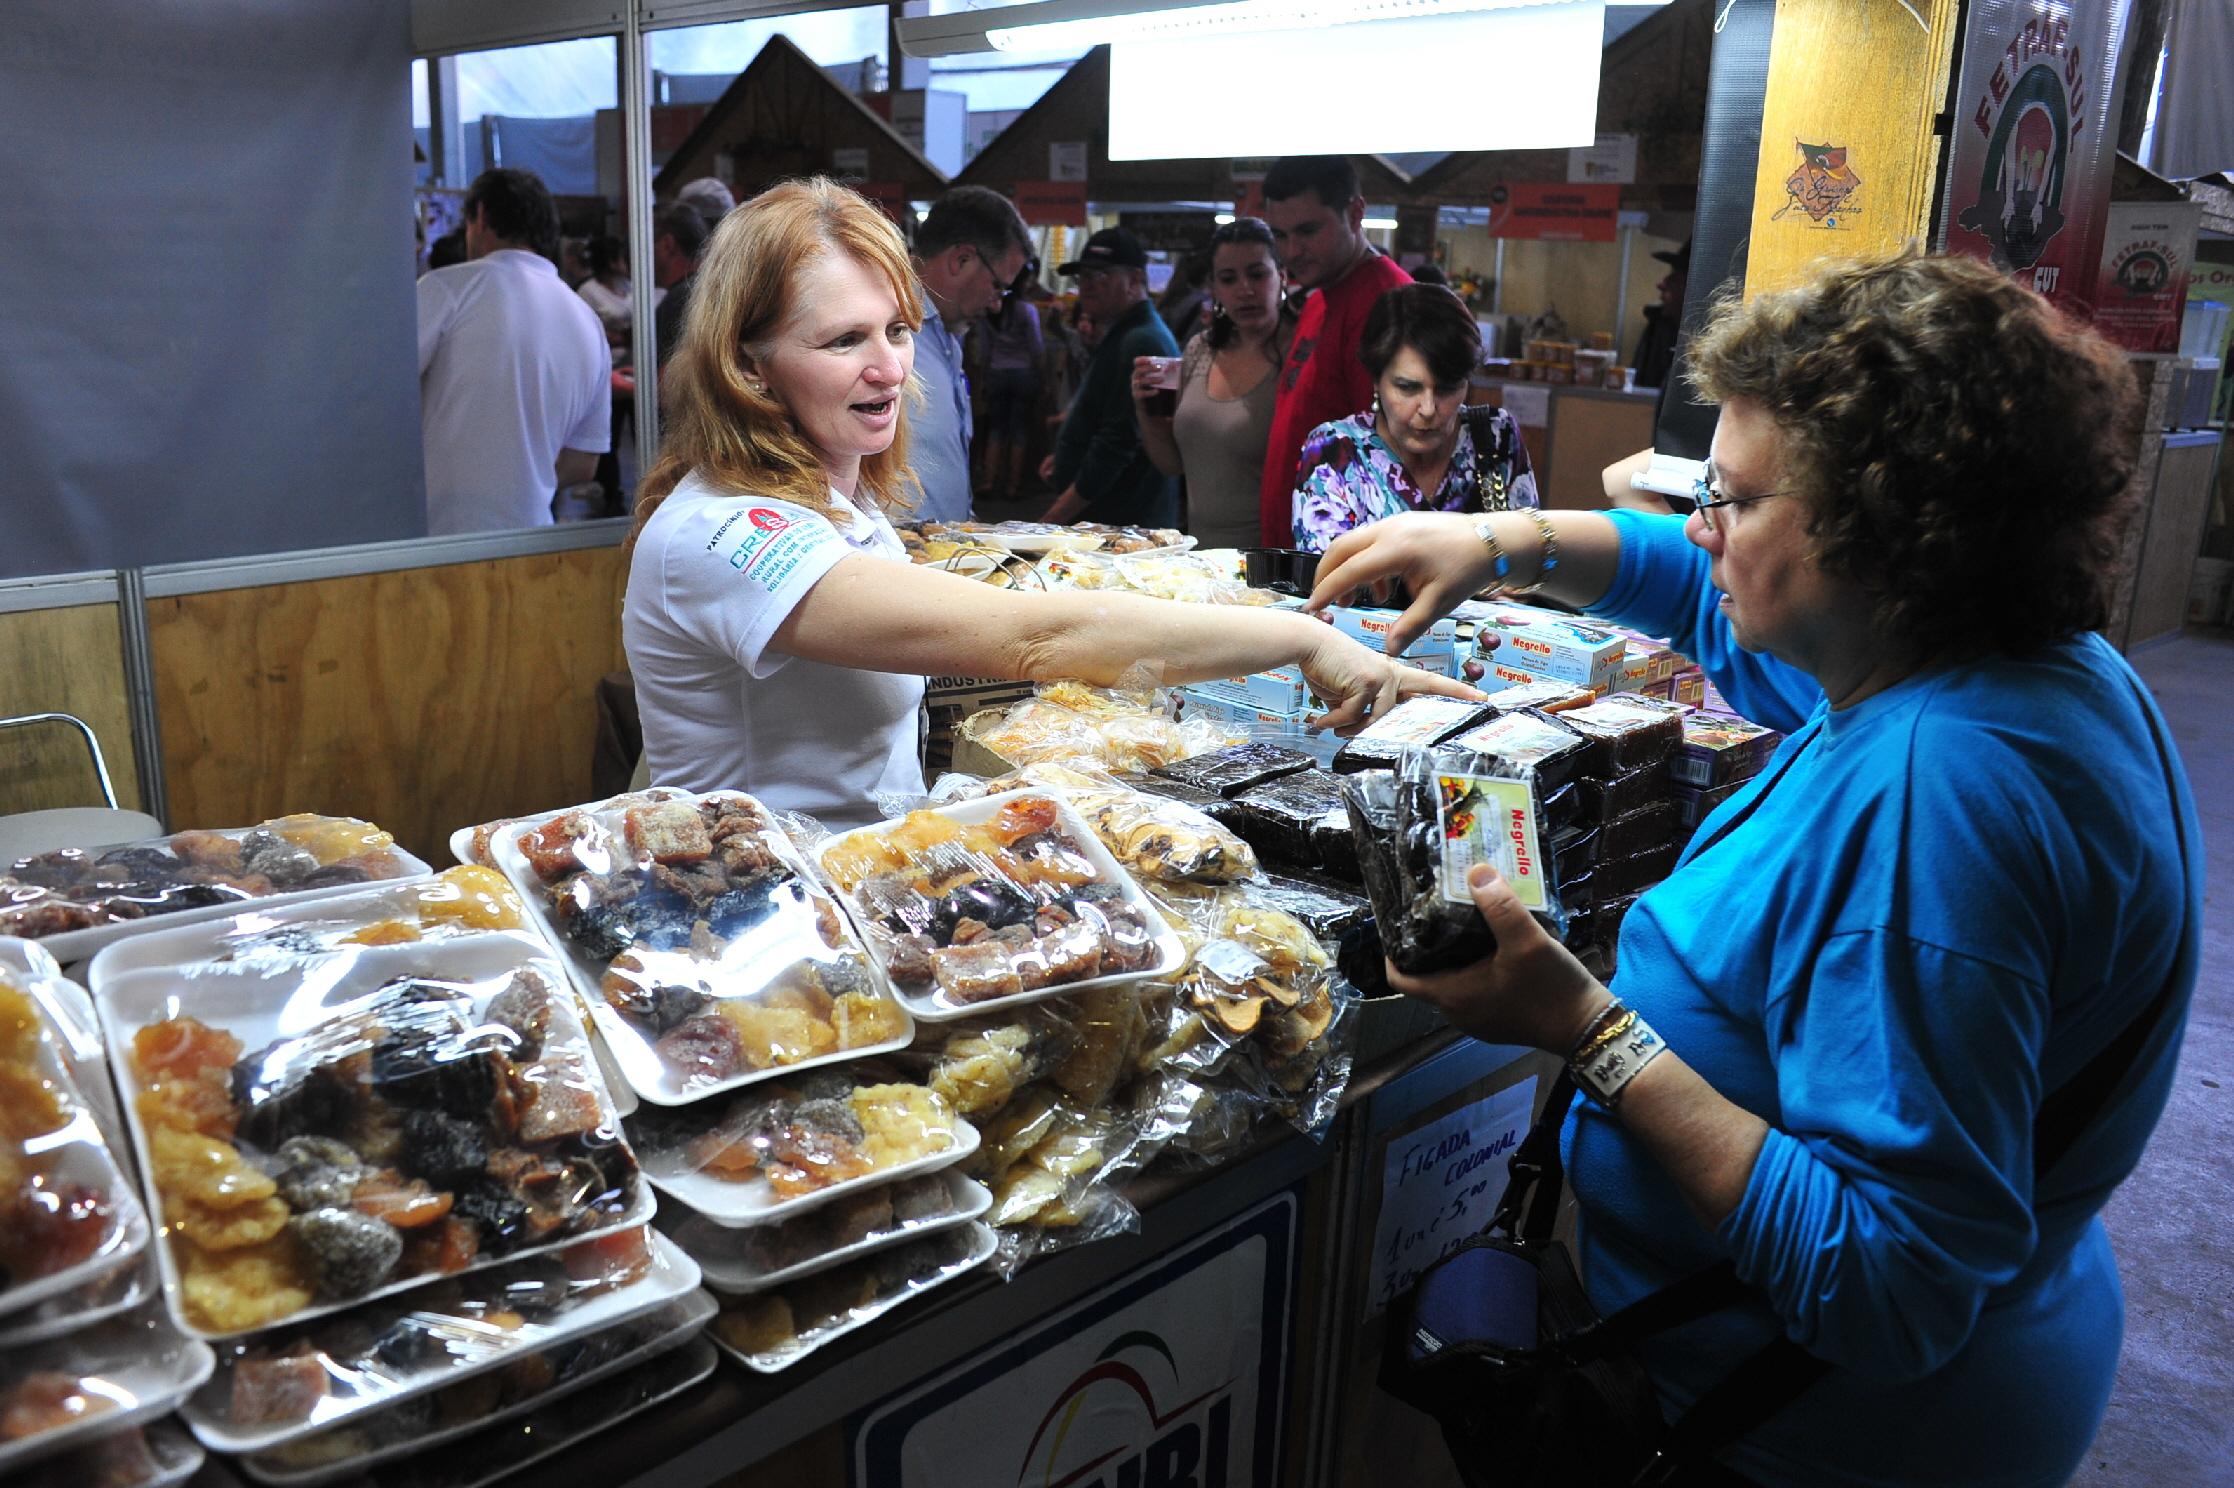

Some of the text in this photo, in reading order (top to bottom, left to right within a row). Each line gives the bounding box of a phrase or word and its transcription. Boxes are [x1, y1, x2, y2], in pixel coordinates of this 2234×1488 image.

[1512, 636, 1551, 655] Negrello
[1496, 666, 1532, 684] Negrello
[1509, 808, 1532, 876] Negrello
[1400, 1129, 1471, 1187] FIGADA
[1444, 1129, 1516, 1186] COLONIAL
